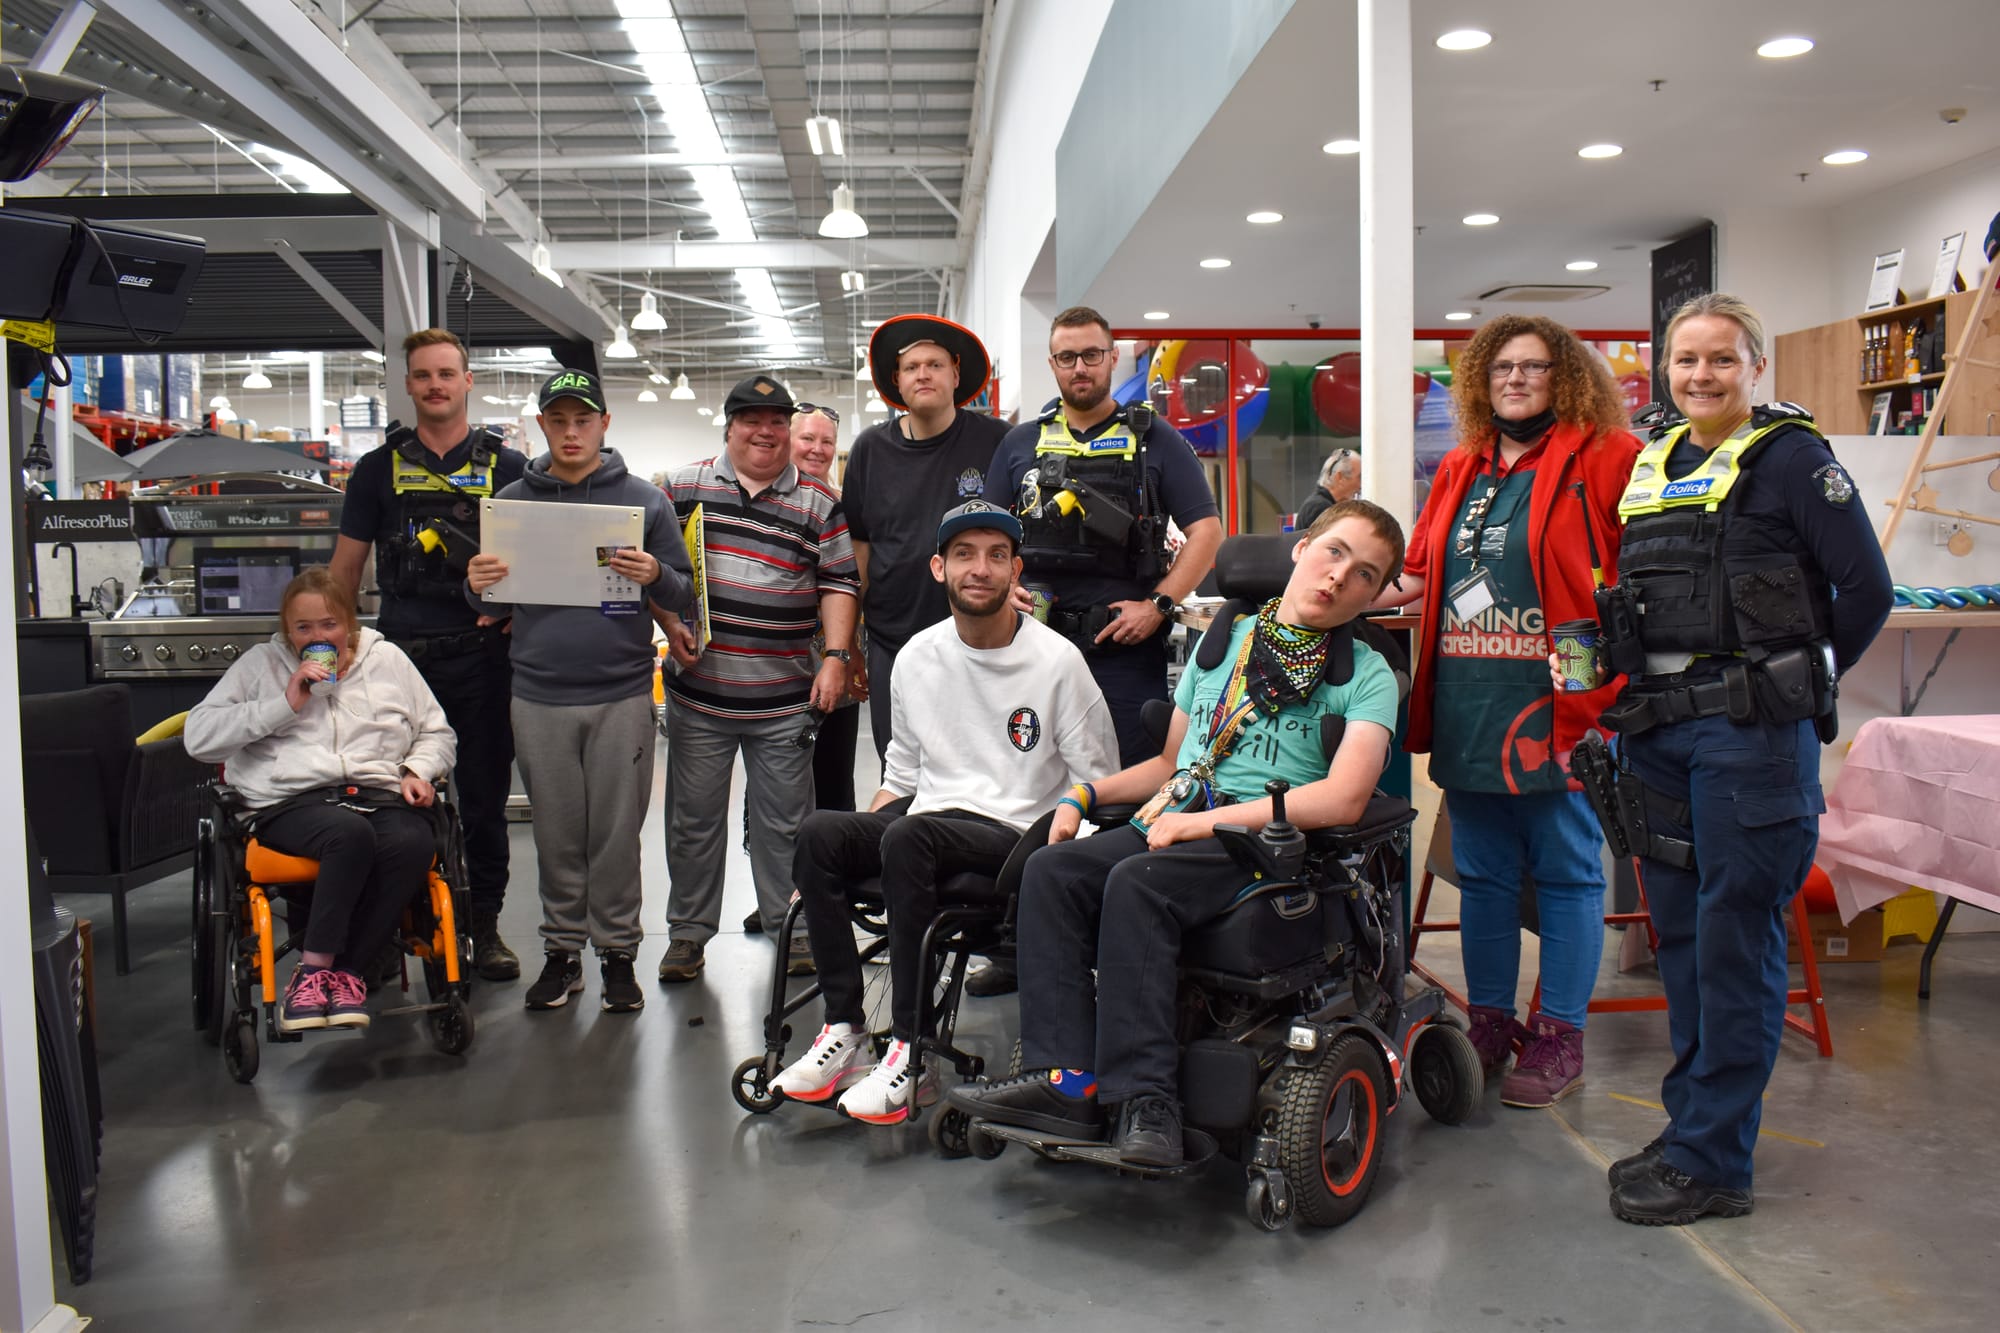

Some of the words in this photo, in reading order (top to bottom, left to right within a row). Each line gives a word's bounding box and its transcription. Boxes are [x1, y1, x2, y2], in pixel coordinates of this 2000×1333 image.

[119, 274, 153, 285] ARLEC
[1093, 439, 1124, 448] Police
[1666, 483, 1706, 494] Police
[42, 514, 129, 529] AlfrescoPlus
[1442, 606, 1545, 634] NNING
[1442, 626, 1548, 657] arehouse
[1195, 702, 1214, 728] th
[1264, 716, 1313, 739] not
[1237, 733, 1279, 766] rill
